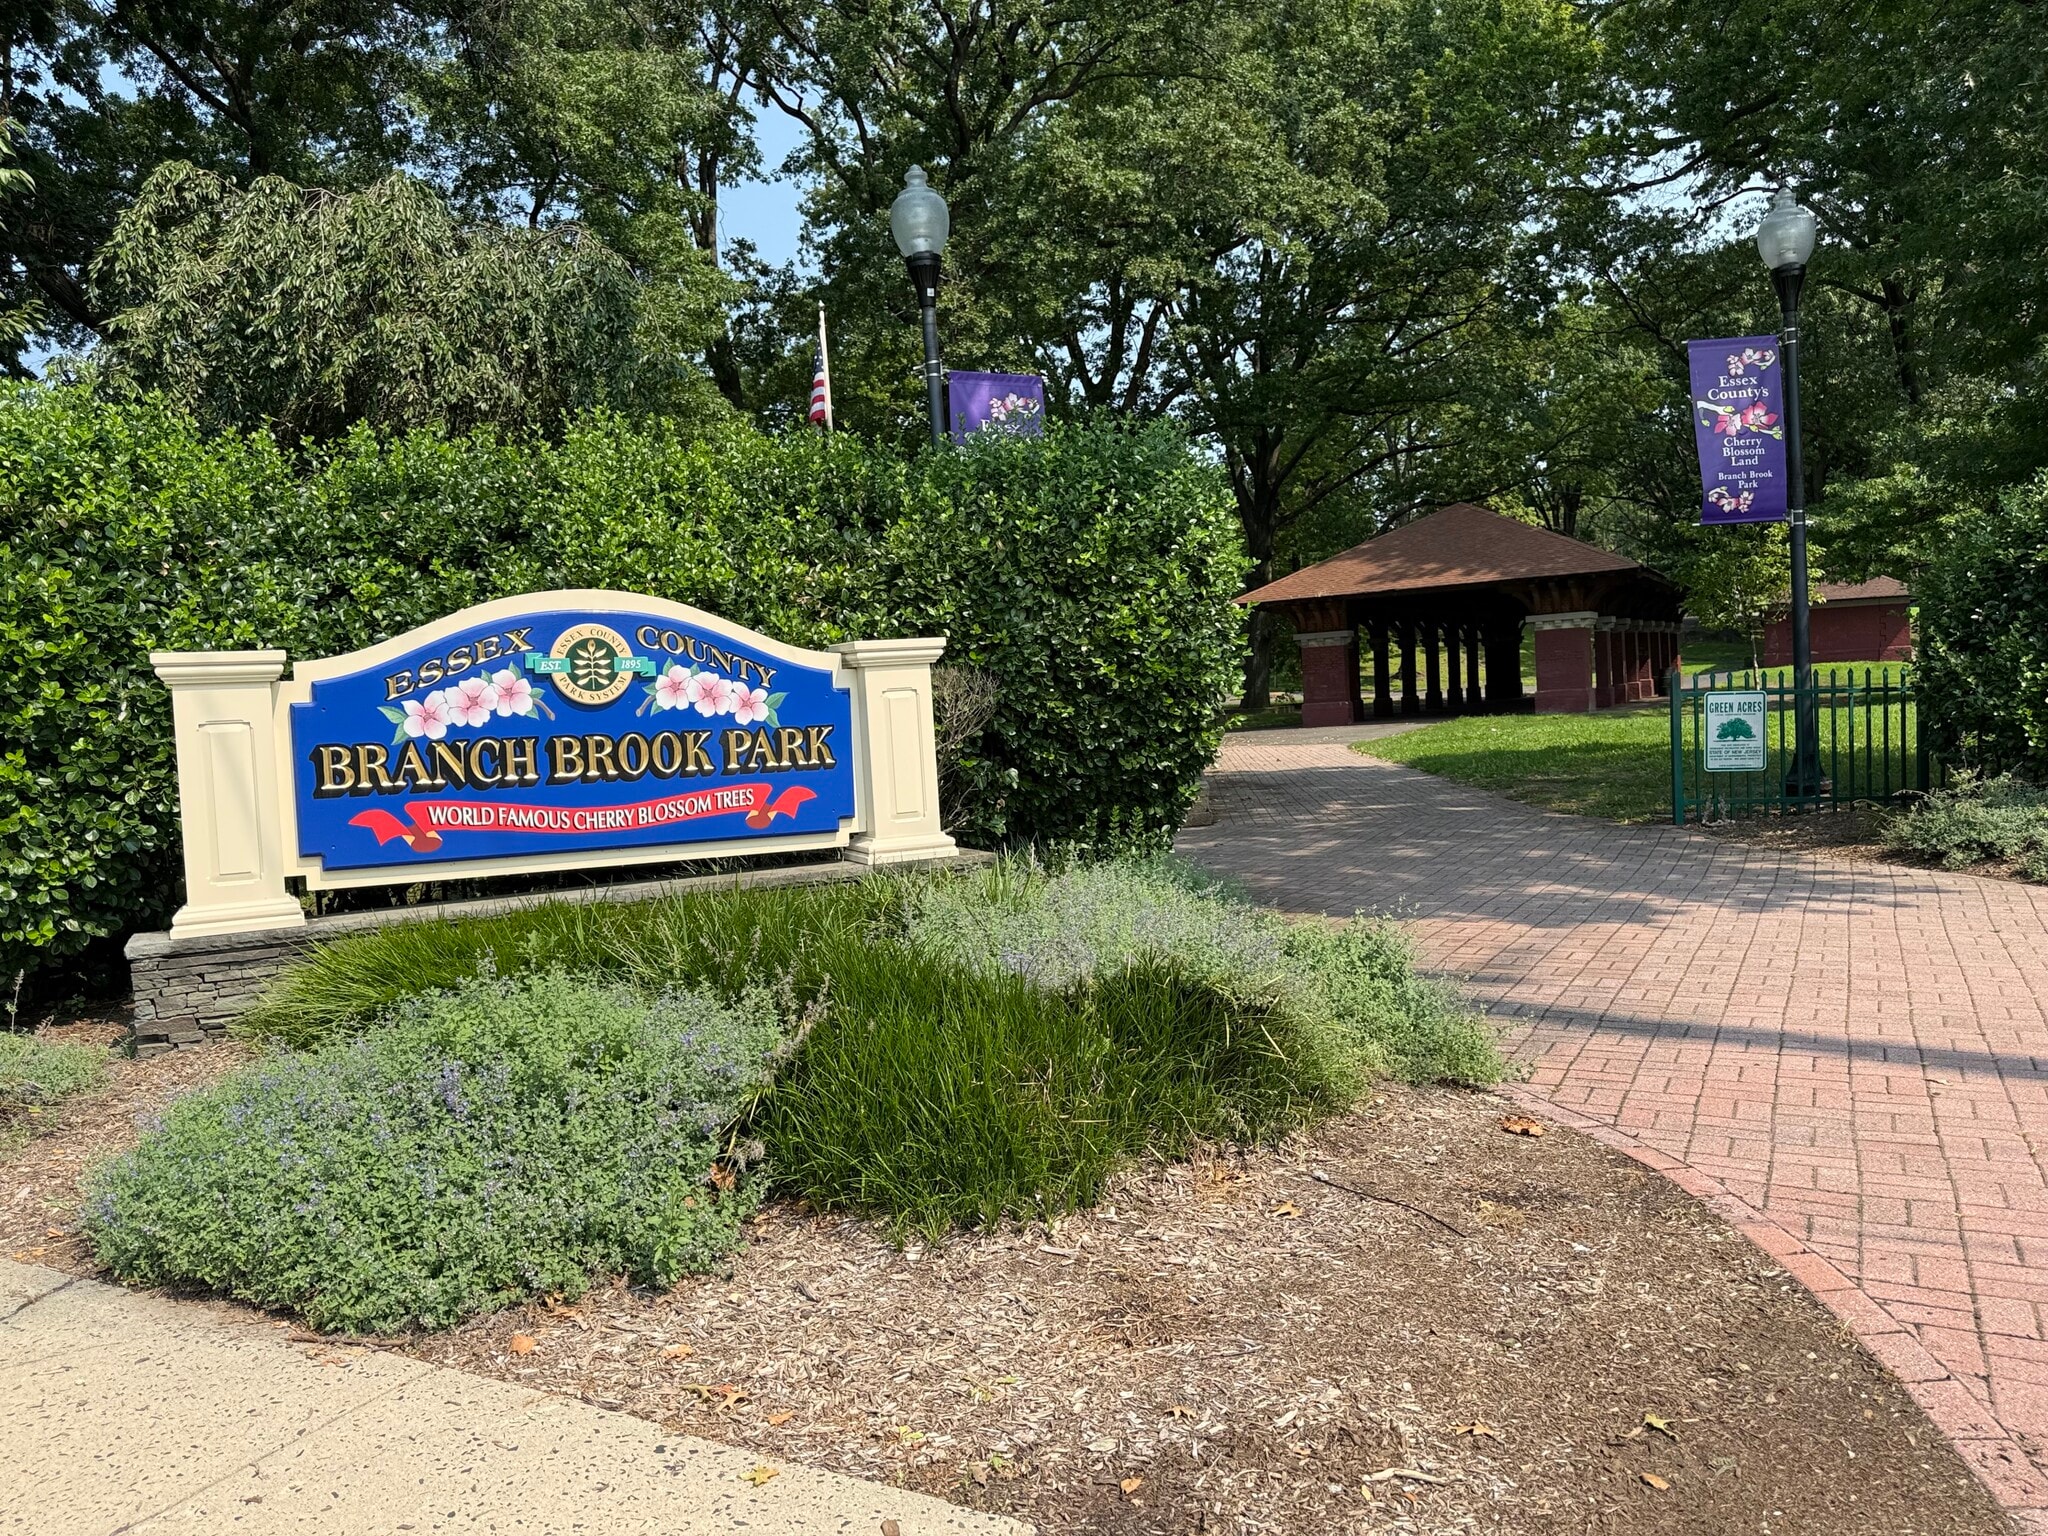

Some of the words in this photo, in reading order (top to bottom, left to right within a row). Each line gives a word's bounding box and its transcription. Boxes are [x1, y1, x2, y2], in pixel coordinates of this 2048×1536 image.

[1718, 375, 1758, 387] Essex
[1707, 386, 1769, 401] County's
[1723, 436, 1762, 448] Cherry
[1722, 447, 1765, 457] Blossom
[1731, 456, 1759, 466] Land
[1718, 471, 1747, 480] Branch
[1749, 470, 1773, 479] Brook
[1738, 480, 1758, 489] Park
[556, 629, 584, 655] ESSEX
[590, 628, 627, 655] COUNTY
[385, 626, 535, 702] ESSEX
[636, 625, 778, 690] COUNTY
[540, 661, 562, 671] EST.
[621, 660, 641, 669] 1895
[559, 676, 584, 699] PARK
[589, 676, 627, 701] SYSTEM
[1709, 702, 1734, 713] GREEN
[1736, 701, 1762, 713] ACRES
[314, 736, 540, 795] BRANCH
[550, 730, 715, 780] BROOK
[724, 724, 836, 771] PARK
[428, 805, 495, 827] WORLD
[498, 807, 570, 830] FAMOUS
[573, 809, 635, 830] CHERRY
[638, 795, 712, 823] BLOSSOM
[713, 788, 754, 809] TREES
